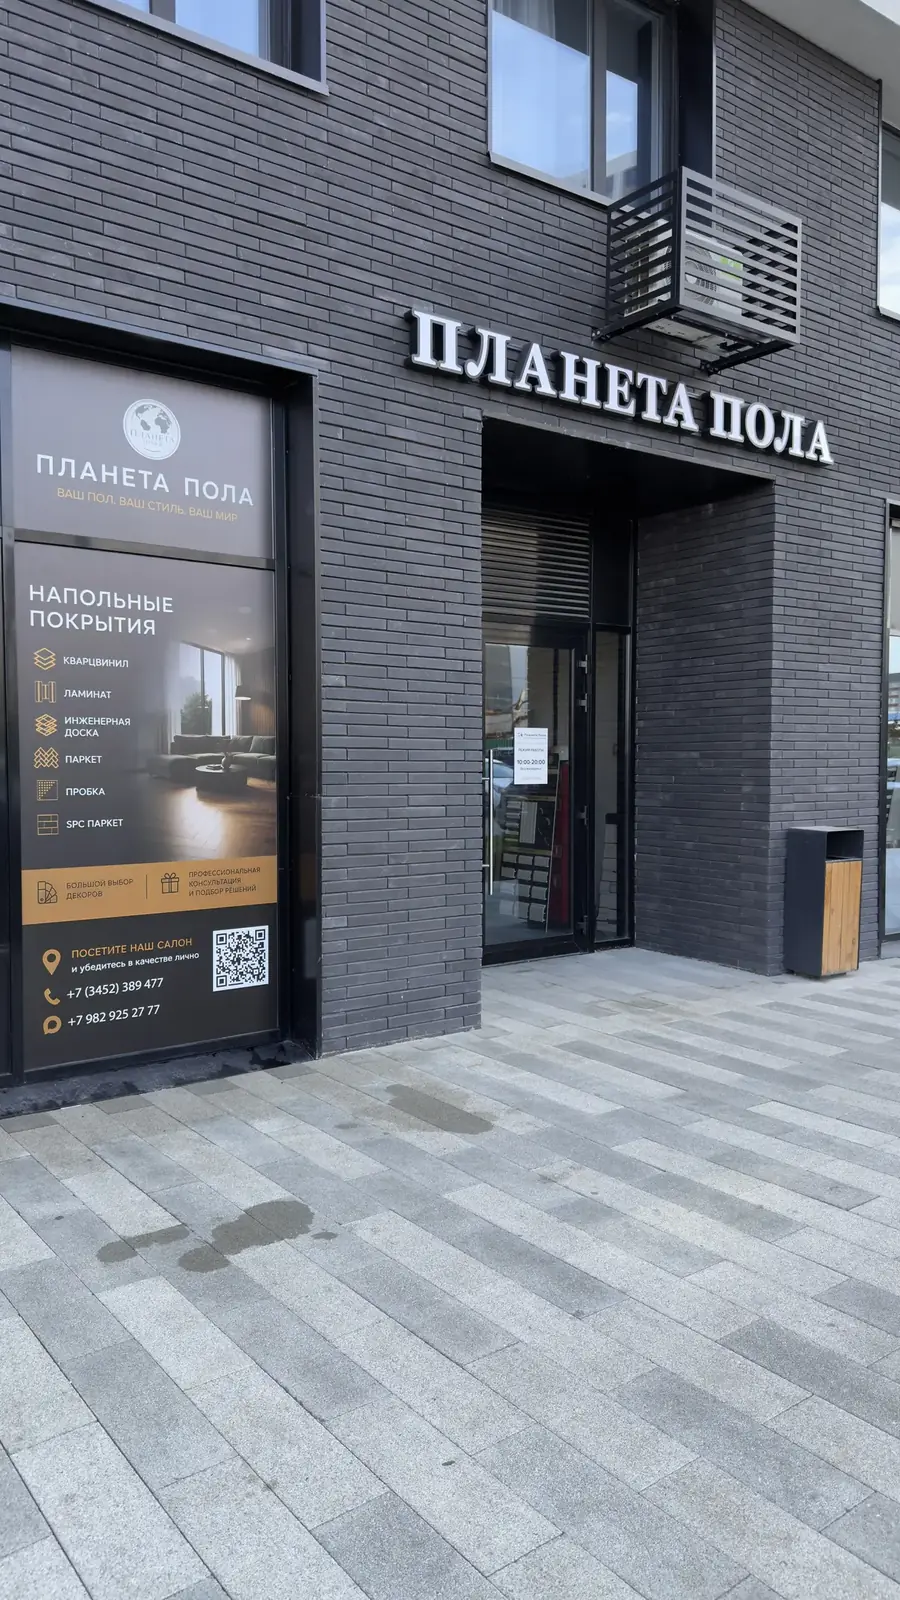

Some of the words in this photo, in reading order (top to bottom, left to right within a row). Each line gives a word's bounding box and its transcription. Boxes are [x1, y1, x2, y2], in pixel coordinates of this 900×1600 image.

[408, 308, 699, 432] ПЛАНЕТА
[708, 390, 835, 466] ПОЛА
[36, 453, 170, 493] ПЛАНЕТА
[184, 477, 254, 506] ПОЛА
[57, 487, 85, 501] ВАШ
[87, 491, 116, 505] ПОЛ.
[119, 496, 145, 509] ВАШ
[147, 500, 186, 515] СТИЛЬ.
[188, 506, 213, 519] ВАШ
[215, 511, 238, 522] МИР
[29, 584, 174, 613] НАПОЛЬНЫЕ
[29, 609, 156, 636] ПОКРЫТИЯ
[63, 656, 129, 668] КВАРЦВИНИЛ
[63, 689, 112, 699] ЛАМИНАТ
[64, 716, 131, 726] ИНЖЕНЕРНАЯ
[64, 728, 99, 738] ДОСКА
[65, 755, 102, 764] ПАРКЕТ
[65, 787, 105, 797] ПРОБКА
[66, 820, 85, 829] SPC
[87, 818, 124, 828] ПАРКЕТ
[188, 866, 261, 878] ПРОФЕССИОНАЛЬНАЯ
[66, 880, 106, 889] БОЛЬШОЙ
[107, 878, 134, 887] ВЫБОР
[188, 877, 242, 887] КОНСУЛЬТАЦИЯ
[66, 890, 103, 900] ДЕКОРОВ
[195, 888, 224, 896] ПОДБОР
[225, 884, 257, 894] РЕШЕНИЙ
[71, 944, 127, 959] ПОСЕТИТЕ
[130, 941, 154, 953] НАШ
[157, 938, 193, 950] САЛОН
[79, 961, 126, 975] убедитесь
[135, 955, 173, 966] качестве
[174, 952, 200, 961] лично
[66, 987, 82, 999] +7
[84, 982, 120, 999] (3452)
[121, 980, 142, 993] 389
[143, 977, 164, 989] 477
[67, 1015, 83, 1027] +7
[85, 1011, 106, 1025] 982
[108, 1008, 129, 1021] 925
[131, 1006, 145, 1018] 27
[147, 1004, 161, 1016] 77
